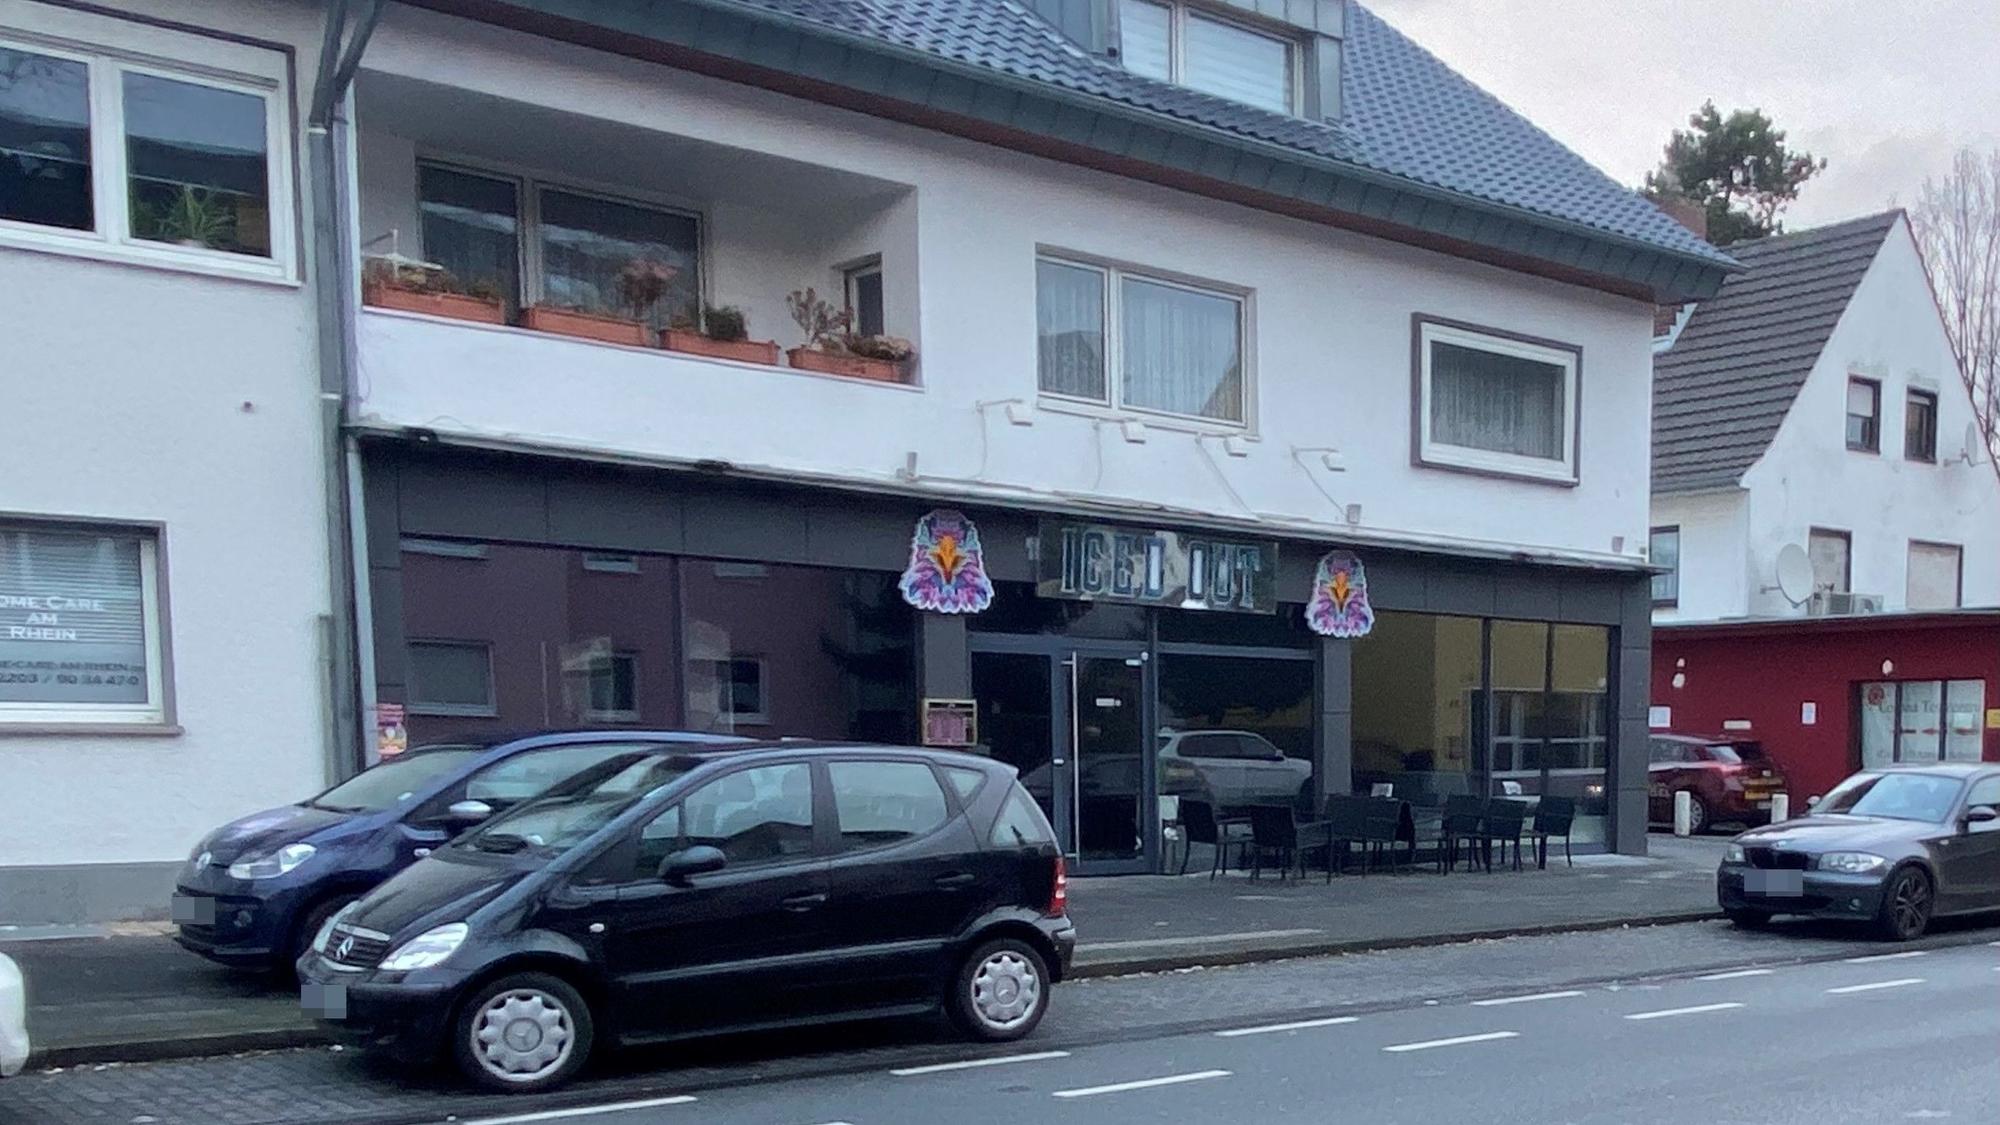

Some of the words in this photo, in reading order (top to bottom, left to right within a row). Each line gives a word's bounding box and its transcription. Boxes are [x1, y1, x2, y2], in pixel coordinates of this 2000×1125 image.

[1061, 527, 1167, 599] ICED
[1186, 540, 1261, 609] OUT
[47, 596, 104, 611] CARE
[25, 612, 58, 625] AM
[10, 626, 77, 640] RHEIN
